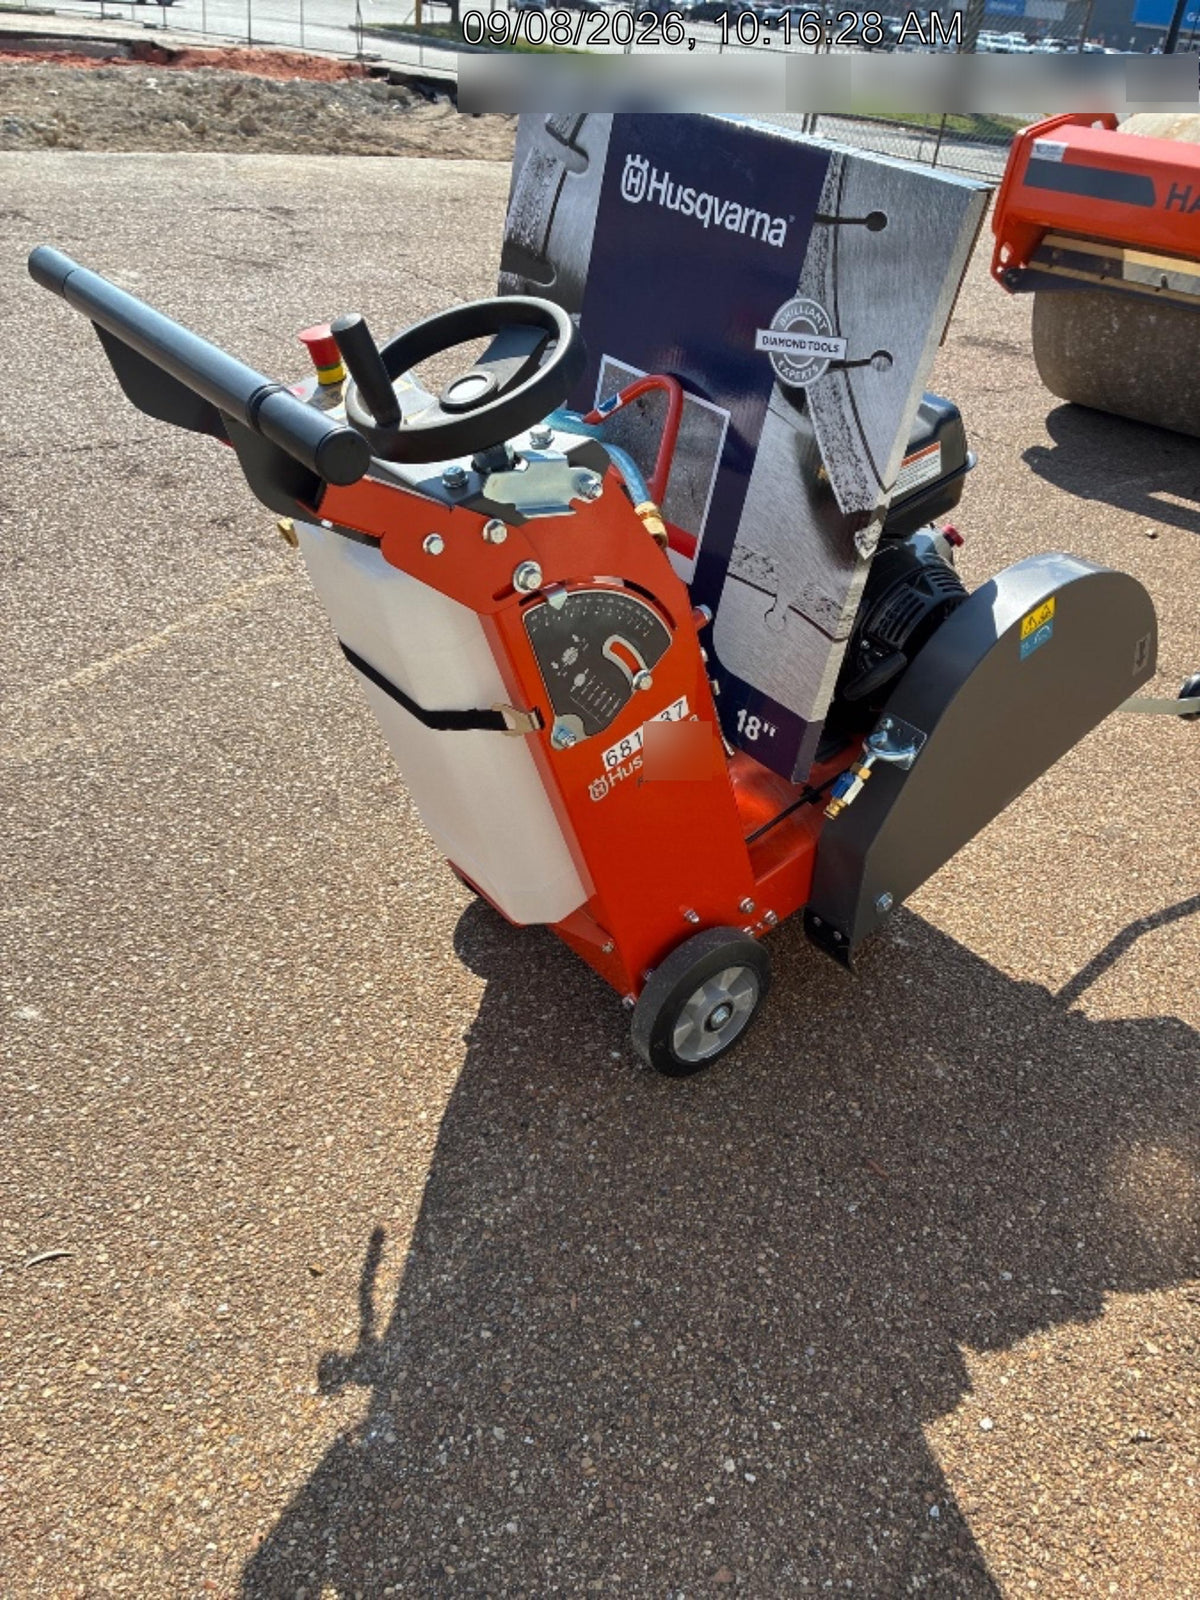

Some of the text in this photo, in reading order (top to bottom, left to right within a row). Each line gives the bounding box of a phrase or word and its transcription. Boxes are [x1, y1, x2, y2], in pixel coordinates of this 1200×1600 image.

[647, 167, 788, 248] Husqvarna
[762, 336, 840, 354] DIAMOND TOOLS
[737, 709, 776, 740] 18"
